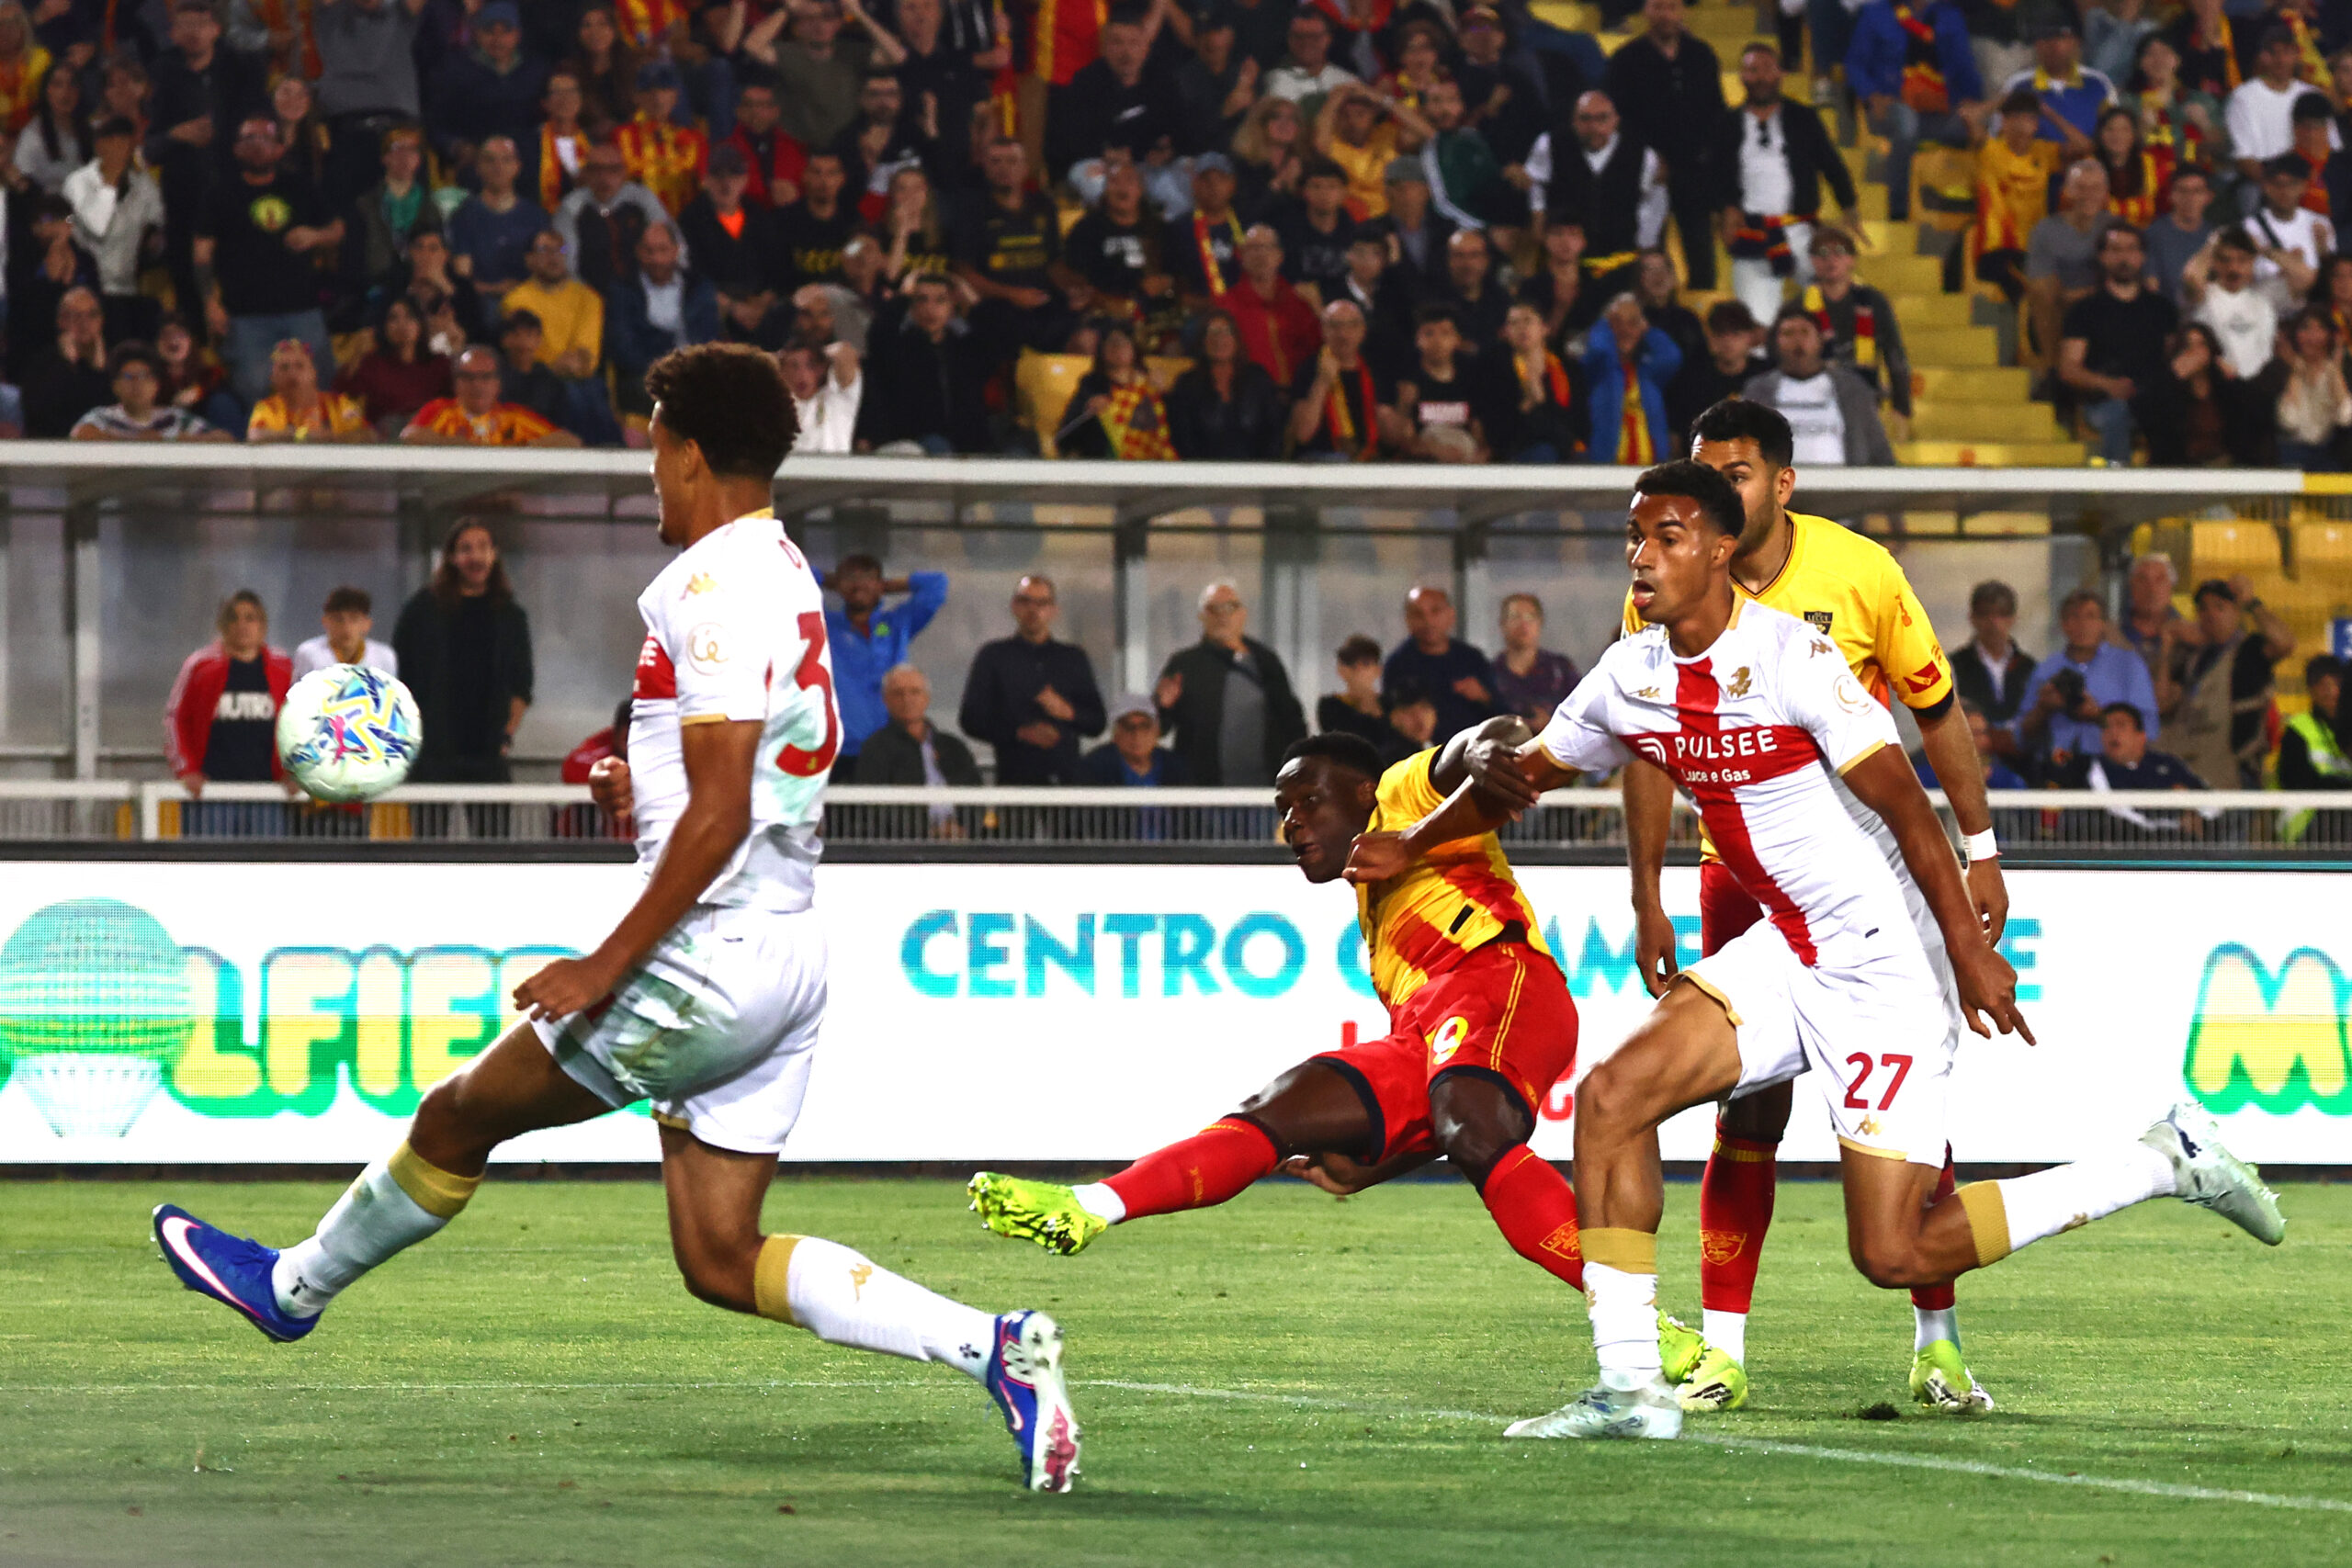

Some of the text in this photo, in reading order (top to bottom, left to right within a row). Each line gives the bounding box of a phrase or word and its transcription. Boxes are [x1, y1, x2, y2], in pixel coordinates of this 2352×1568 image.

[1674, 728, 1778, 760] PULSEE
[1711, 771, 1719, 783] e
[1721, 768, 1751, 783] Gas
[899, 909, 1307, 998] CENTRO
[1425, 1015, 1469, 1066] 9
[2183, 942, 2352, 1116] M
[1844, 1051, 1914, 1111] 27
